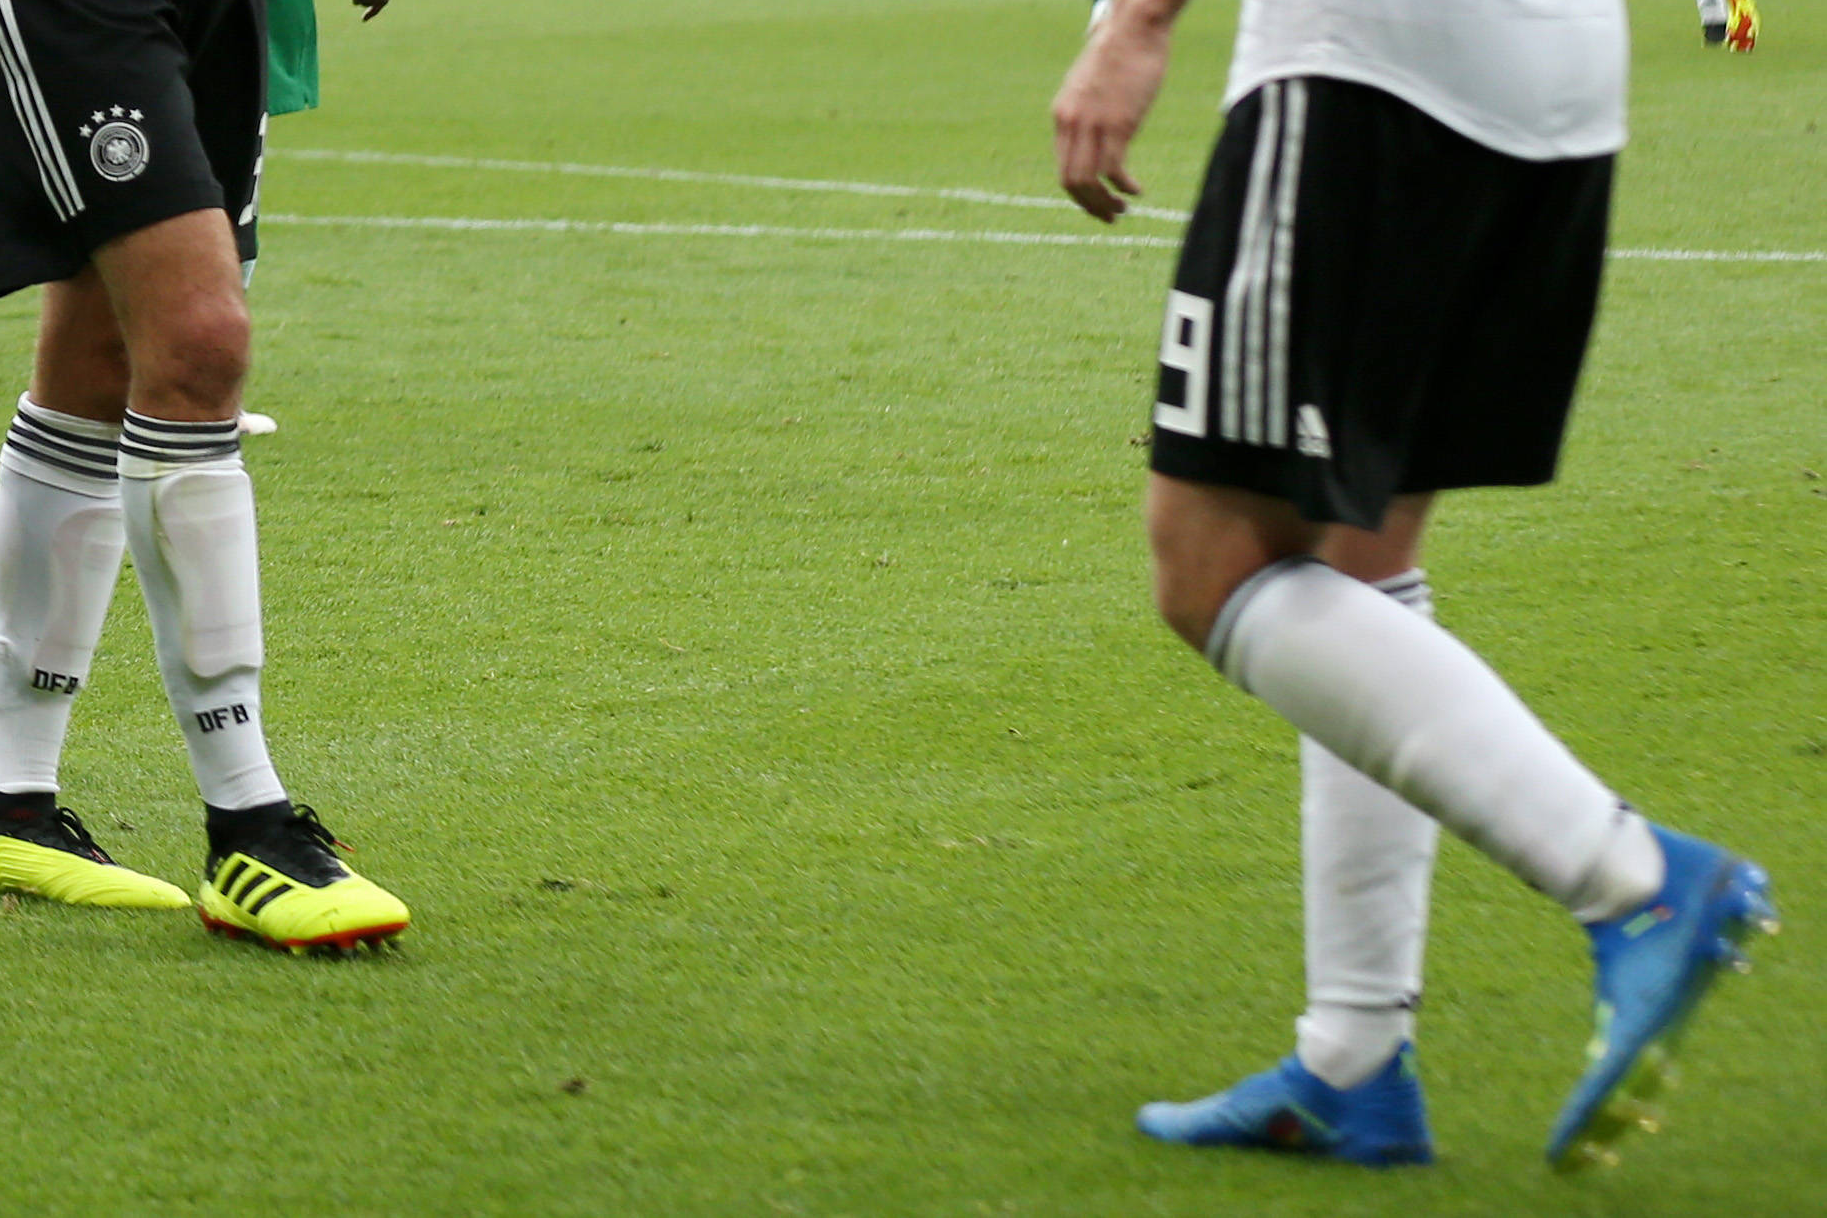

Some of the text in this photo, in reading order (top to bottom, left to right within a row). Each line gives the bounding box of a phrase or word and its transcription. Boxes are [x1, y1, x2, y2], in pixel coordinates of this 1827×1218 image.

[1153, 289, 1214, 438] 9
[32, 668, 79, 695] DFB
[195, 704, 249, 734] DFB
